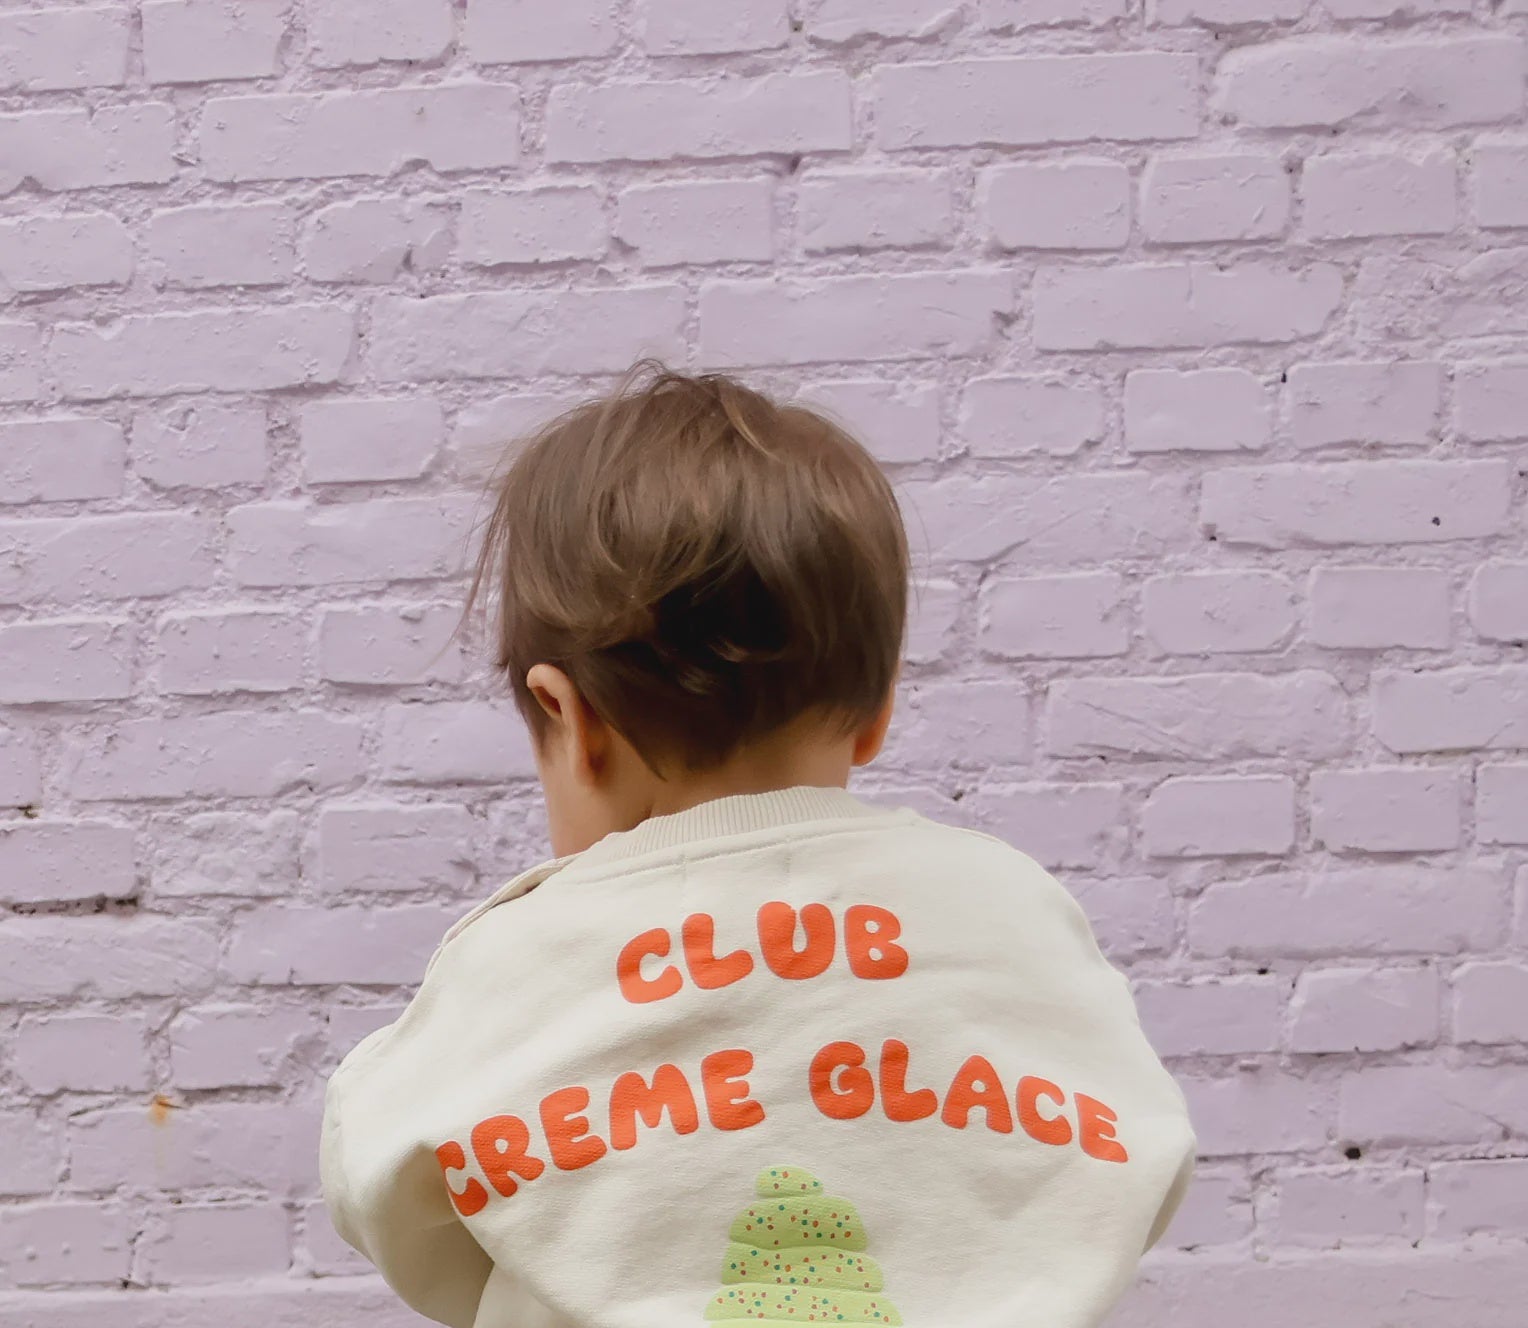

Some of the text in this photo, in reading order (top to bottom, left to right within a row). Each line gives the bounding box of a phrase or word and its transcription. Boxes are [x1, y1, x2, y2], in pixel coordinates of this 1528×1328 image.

[617, 901, 909, 1003] CLUB
[434, 1039, 1129, 1217] CREME GLACE
